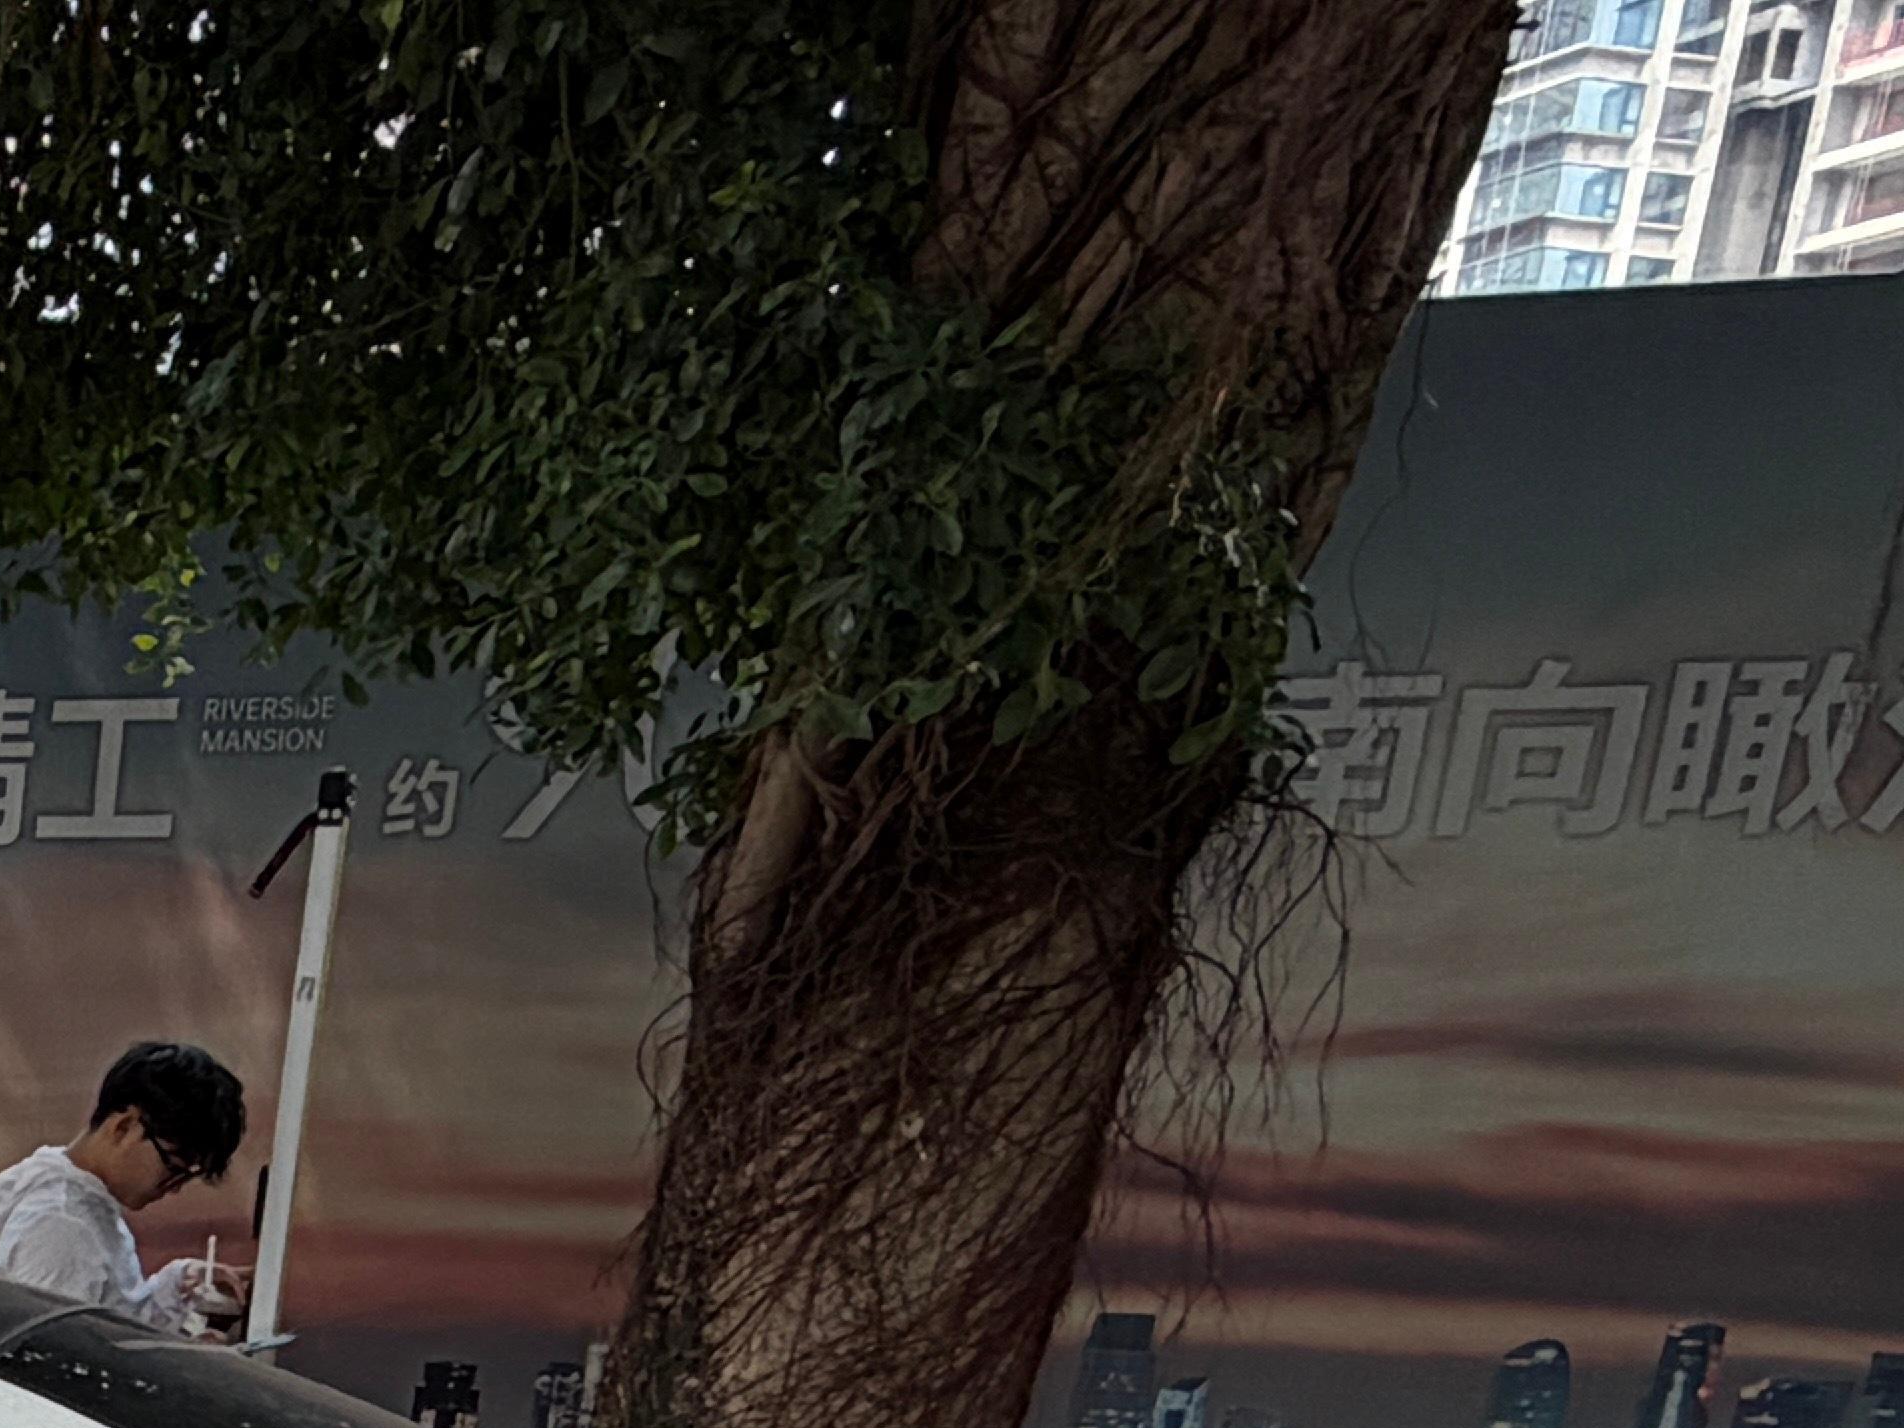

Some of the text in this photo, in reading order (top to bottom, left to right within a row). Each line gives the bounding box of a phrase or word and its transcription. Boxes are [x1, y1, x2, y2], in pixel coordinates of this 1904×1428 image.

[204, 696, 336, 722] RIVERSIDE
[200, 727, 325, 753] MANSION
[1267, 651, 1904, 838] 南向瞰
